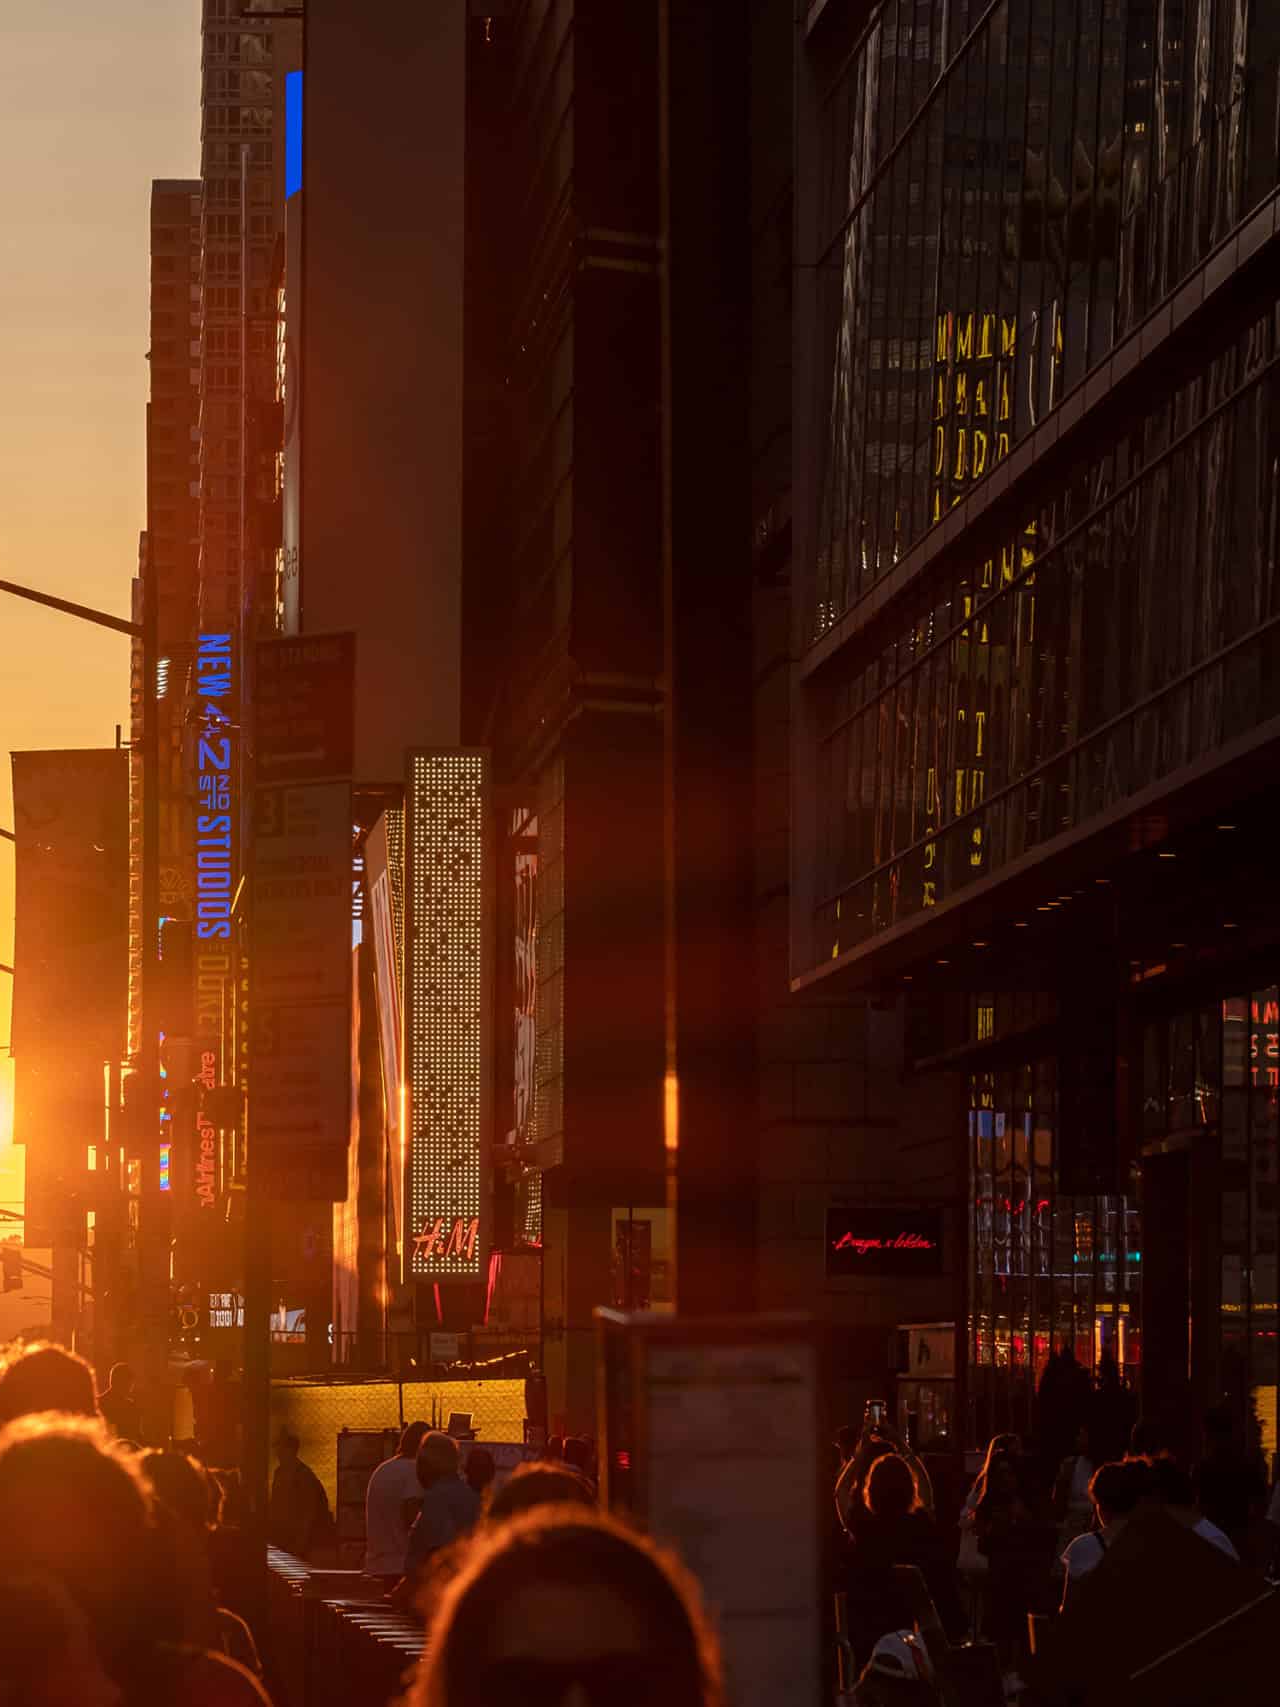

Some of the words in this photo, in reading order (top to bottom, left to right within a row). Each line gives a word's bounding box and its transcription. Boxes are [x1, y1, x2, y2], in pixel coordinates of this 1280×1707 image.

[196, 633, 232, 697] NEW
[196, 815, 232, 938] STUDIOS
[196, 1050, 217, 1130] Tatre
[413, 1217, 480, 1260] H&M
